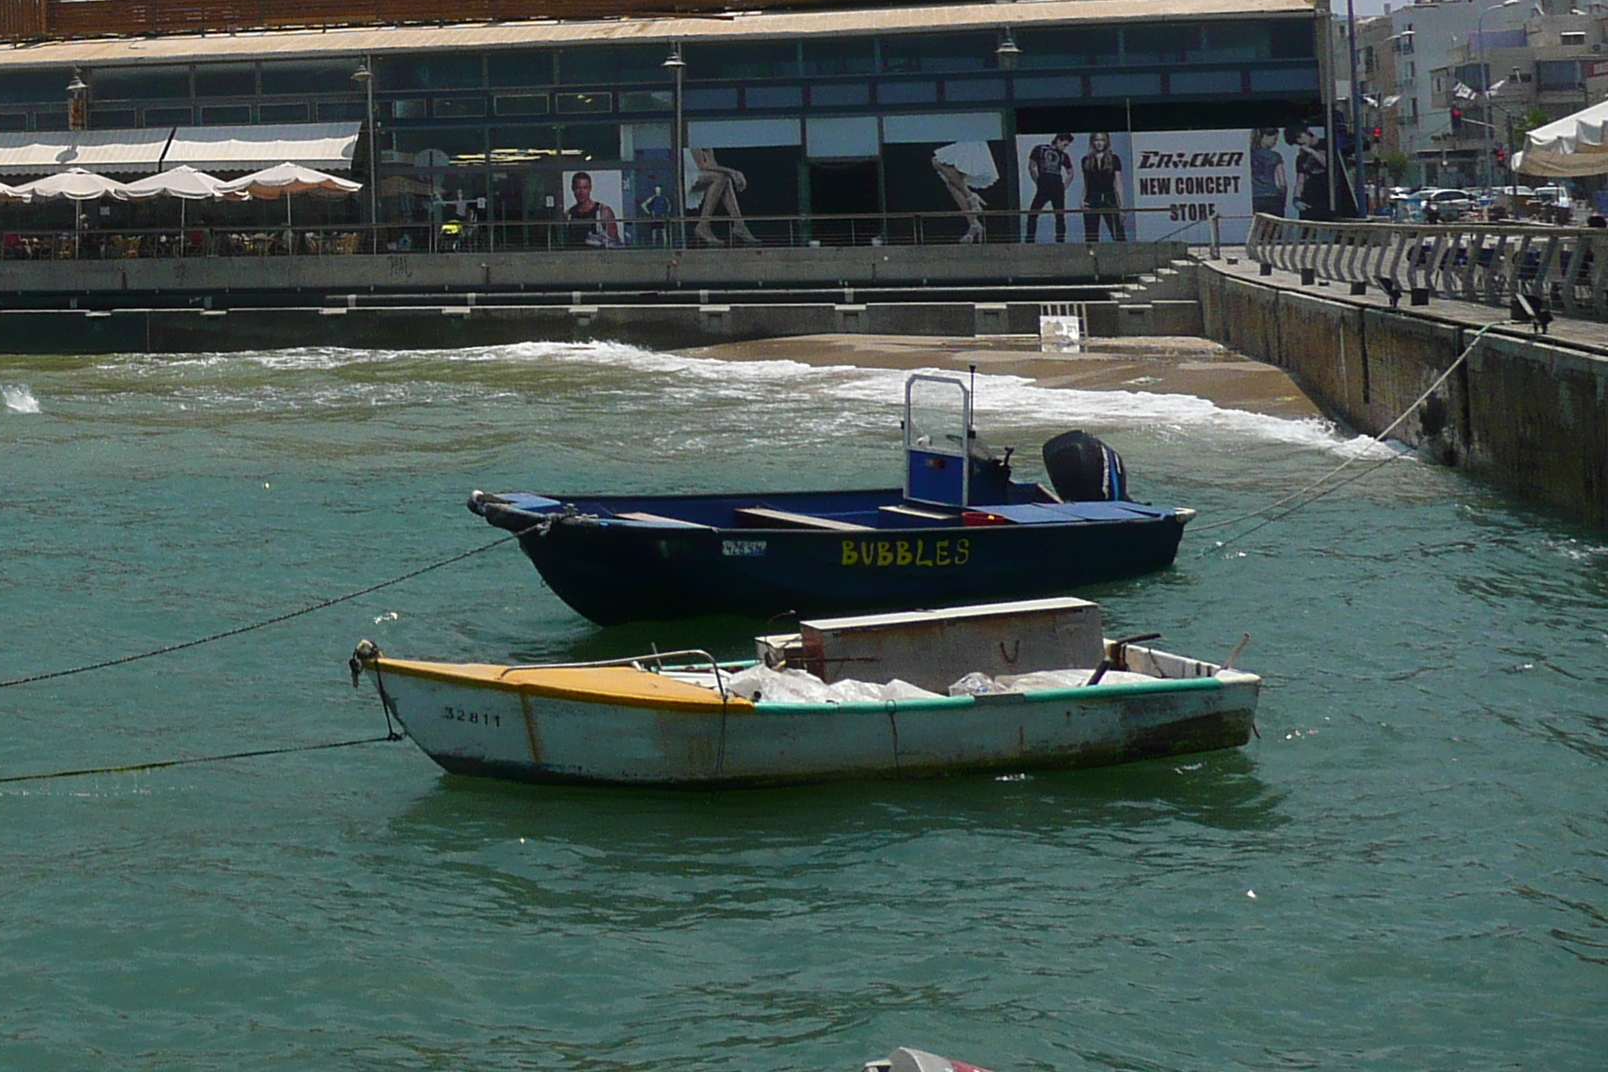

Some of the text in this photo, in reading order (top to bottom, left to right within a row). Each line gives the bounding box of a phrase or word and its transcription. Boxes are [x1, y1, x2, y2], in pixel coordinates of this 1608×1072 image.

[1139, 176, 1241, 196] NEW CONCEPT
[841, 538, 970, 567] BUBBLES
[442, 706, 501, 728] 32811
